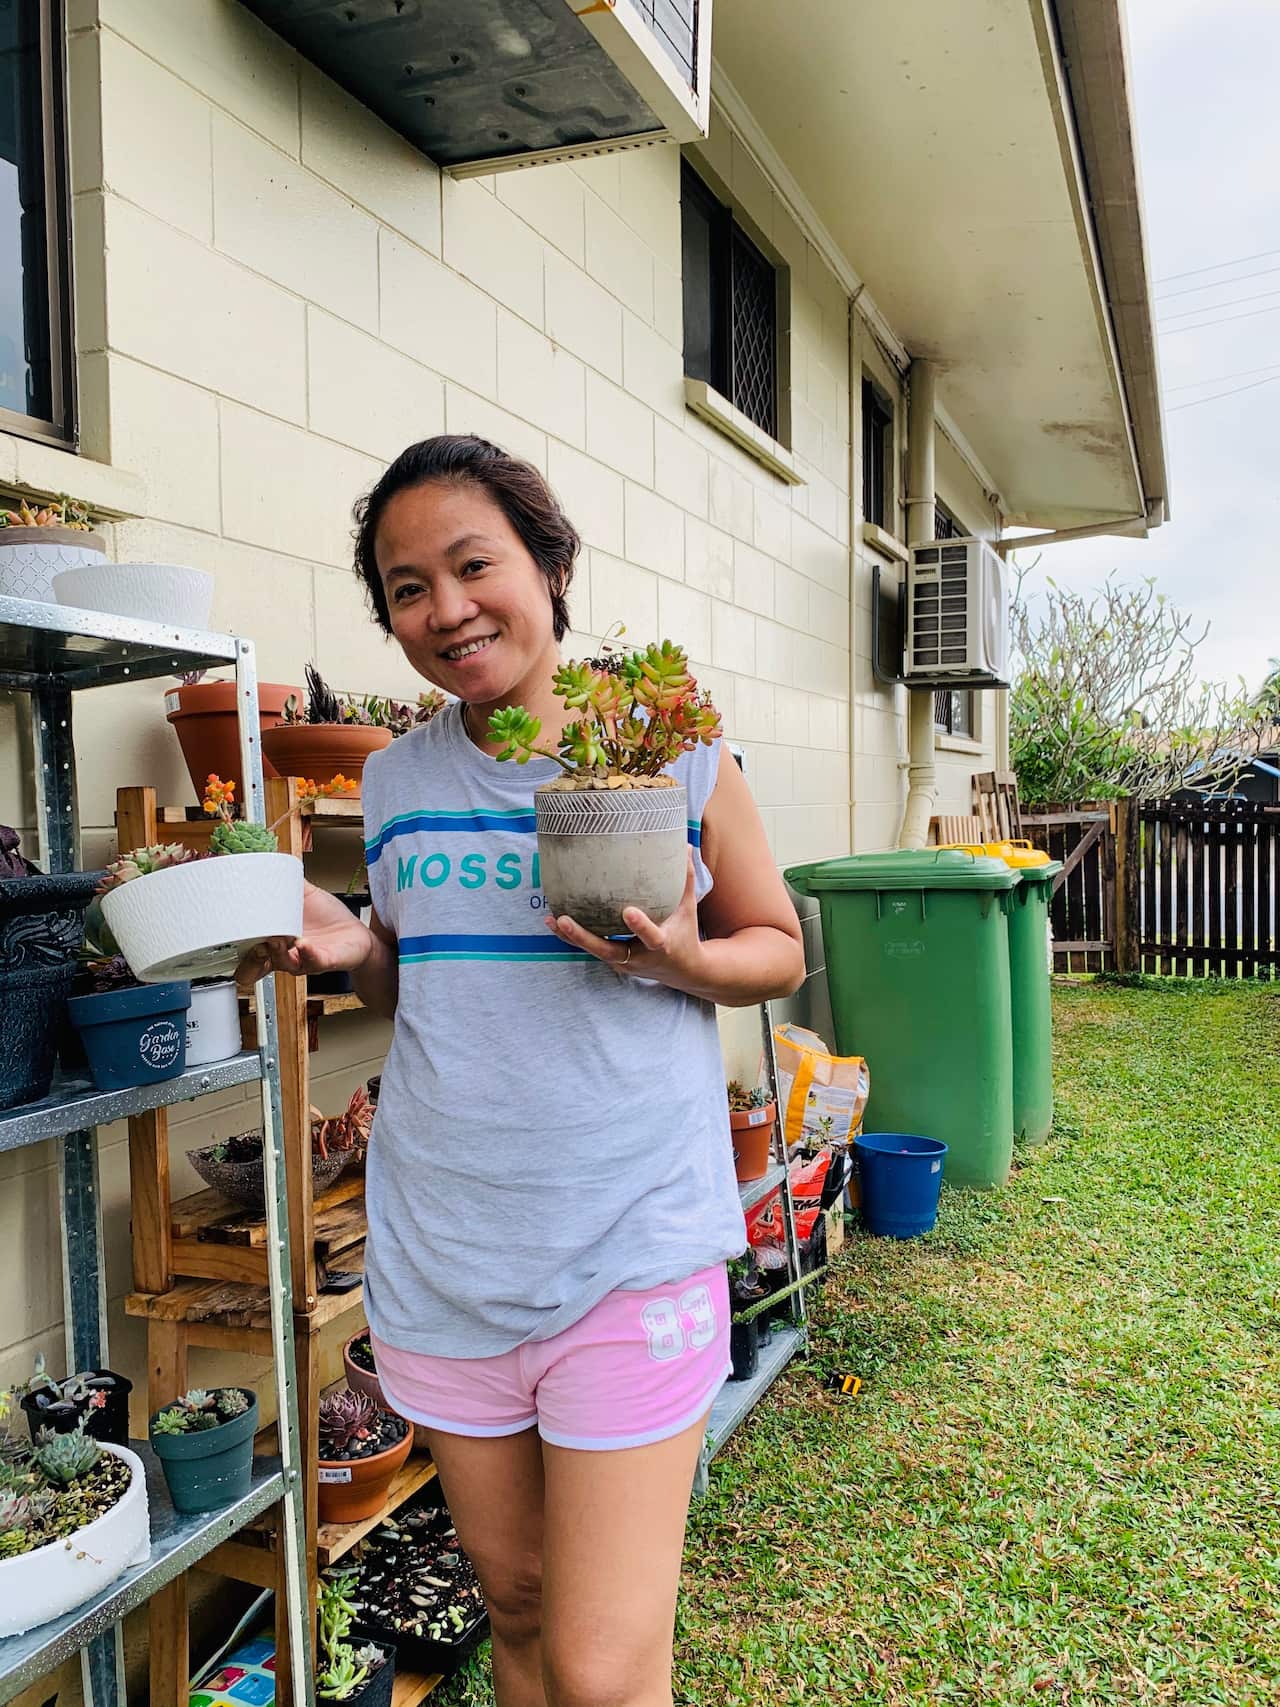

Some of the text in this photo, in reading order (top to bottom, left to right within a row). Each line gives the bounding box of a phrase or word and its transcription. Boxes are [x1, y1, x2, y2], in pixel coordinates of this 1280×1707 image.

[140, 1029, 179, 1053] Garden
[150, 1044, 175, 1061] Base
[640, 1284, 716, 1361] 83
